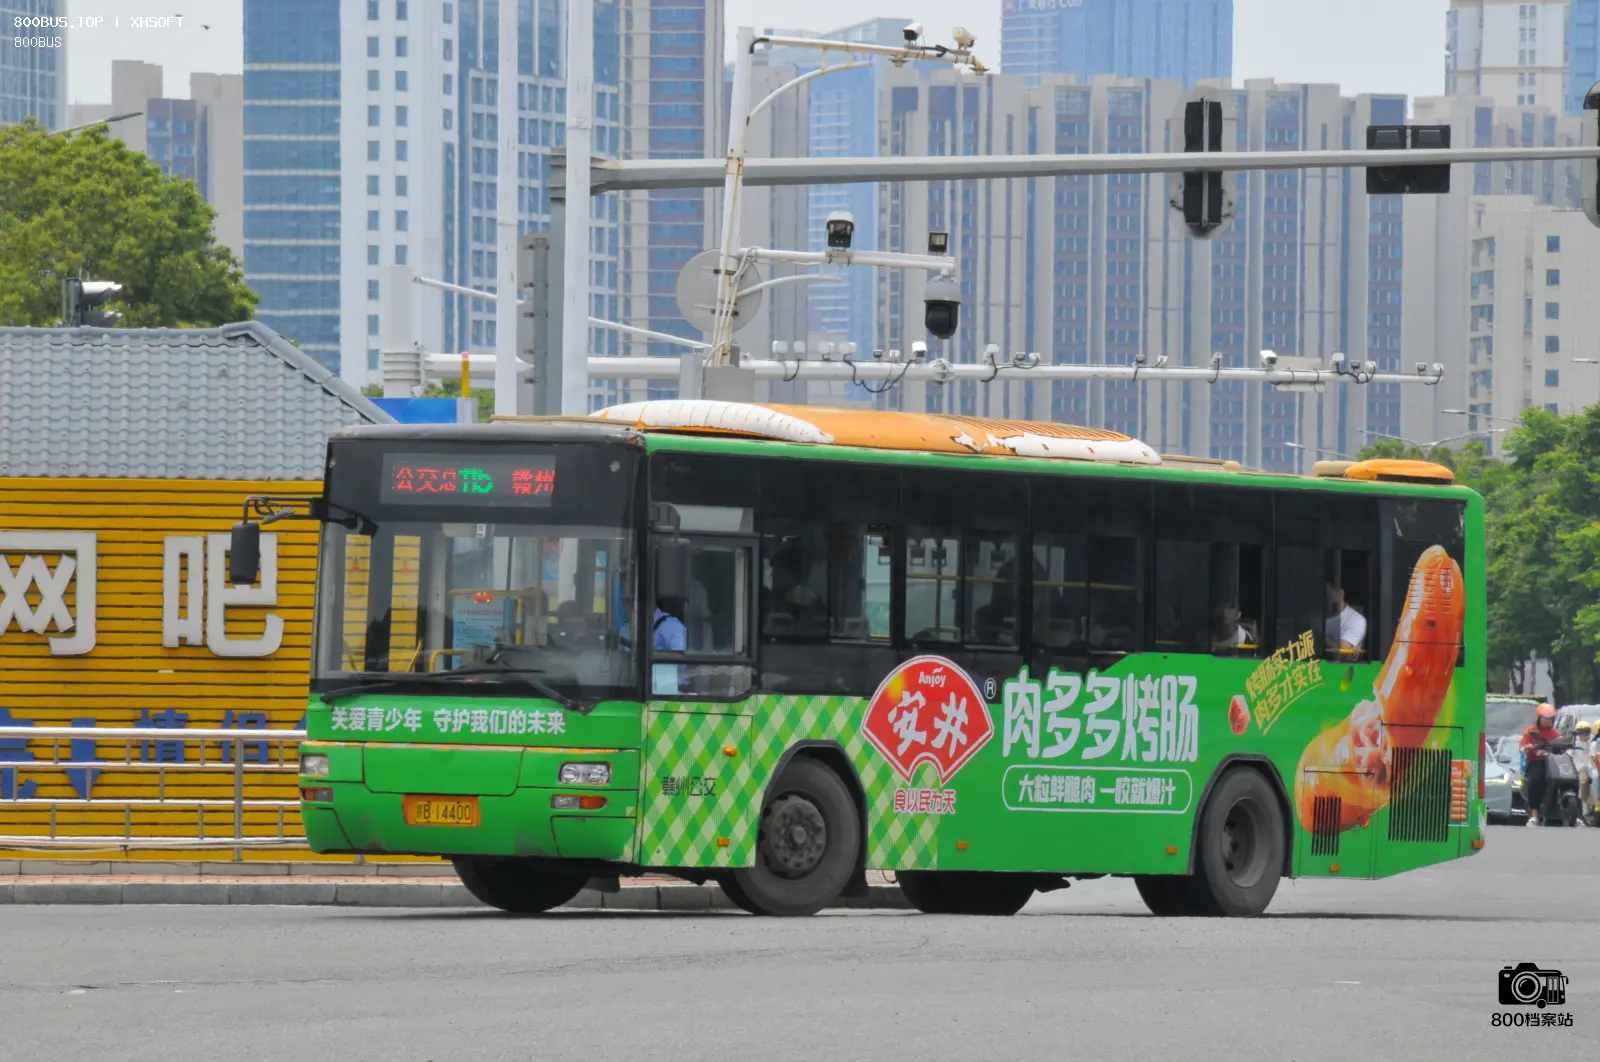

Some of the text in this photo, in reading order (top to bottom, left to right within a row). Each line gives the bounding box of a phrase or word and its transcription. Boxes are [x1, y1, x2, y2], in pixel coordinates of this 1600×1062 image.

[918, 667, 947, 688] Anjoy
[331, 707, 566, 735] 关爱青少年 守护我们的未来
[887, 690, 968, 758] 安井
[1003, 669, 1199, 762] 肉多多烤肠
[894, 788, 956, 814] 食以民为天
